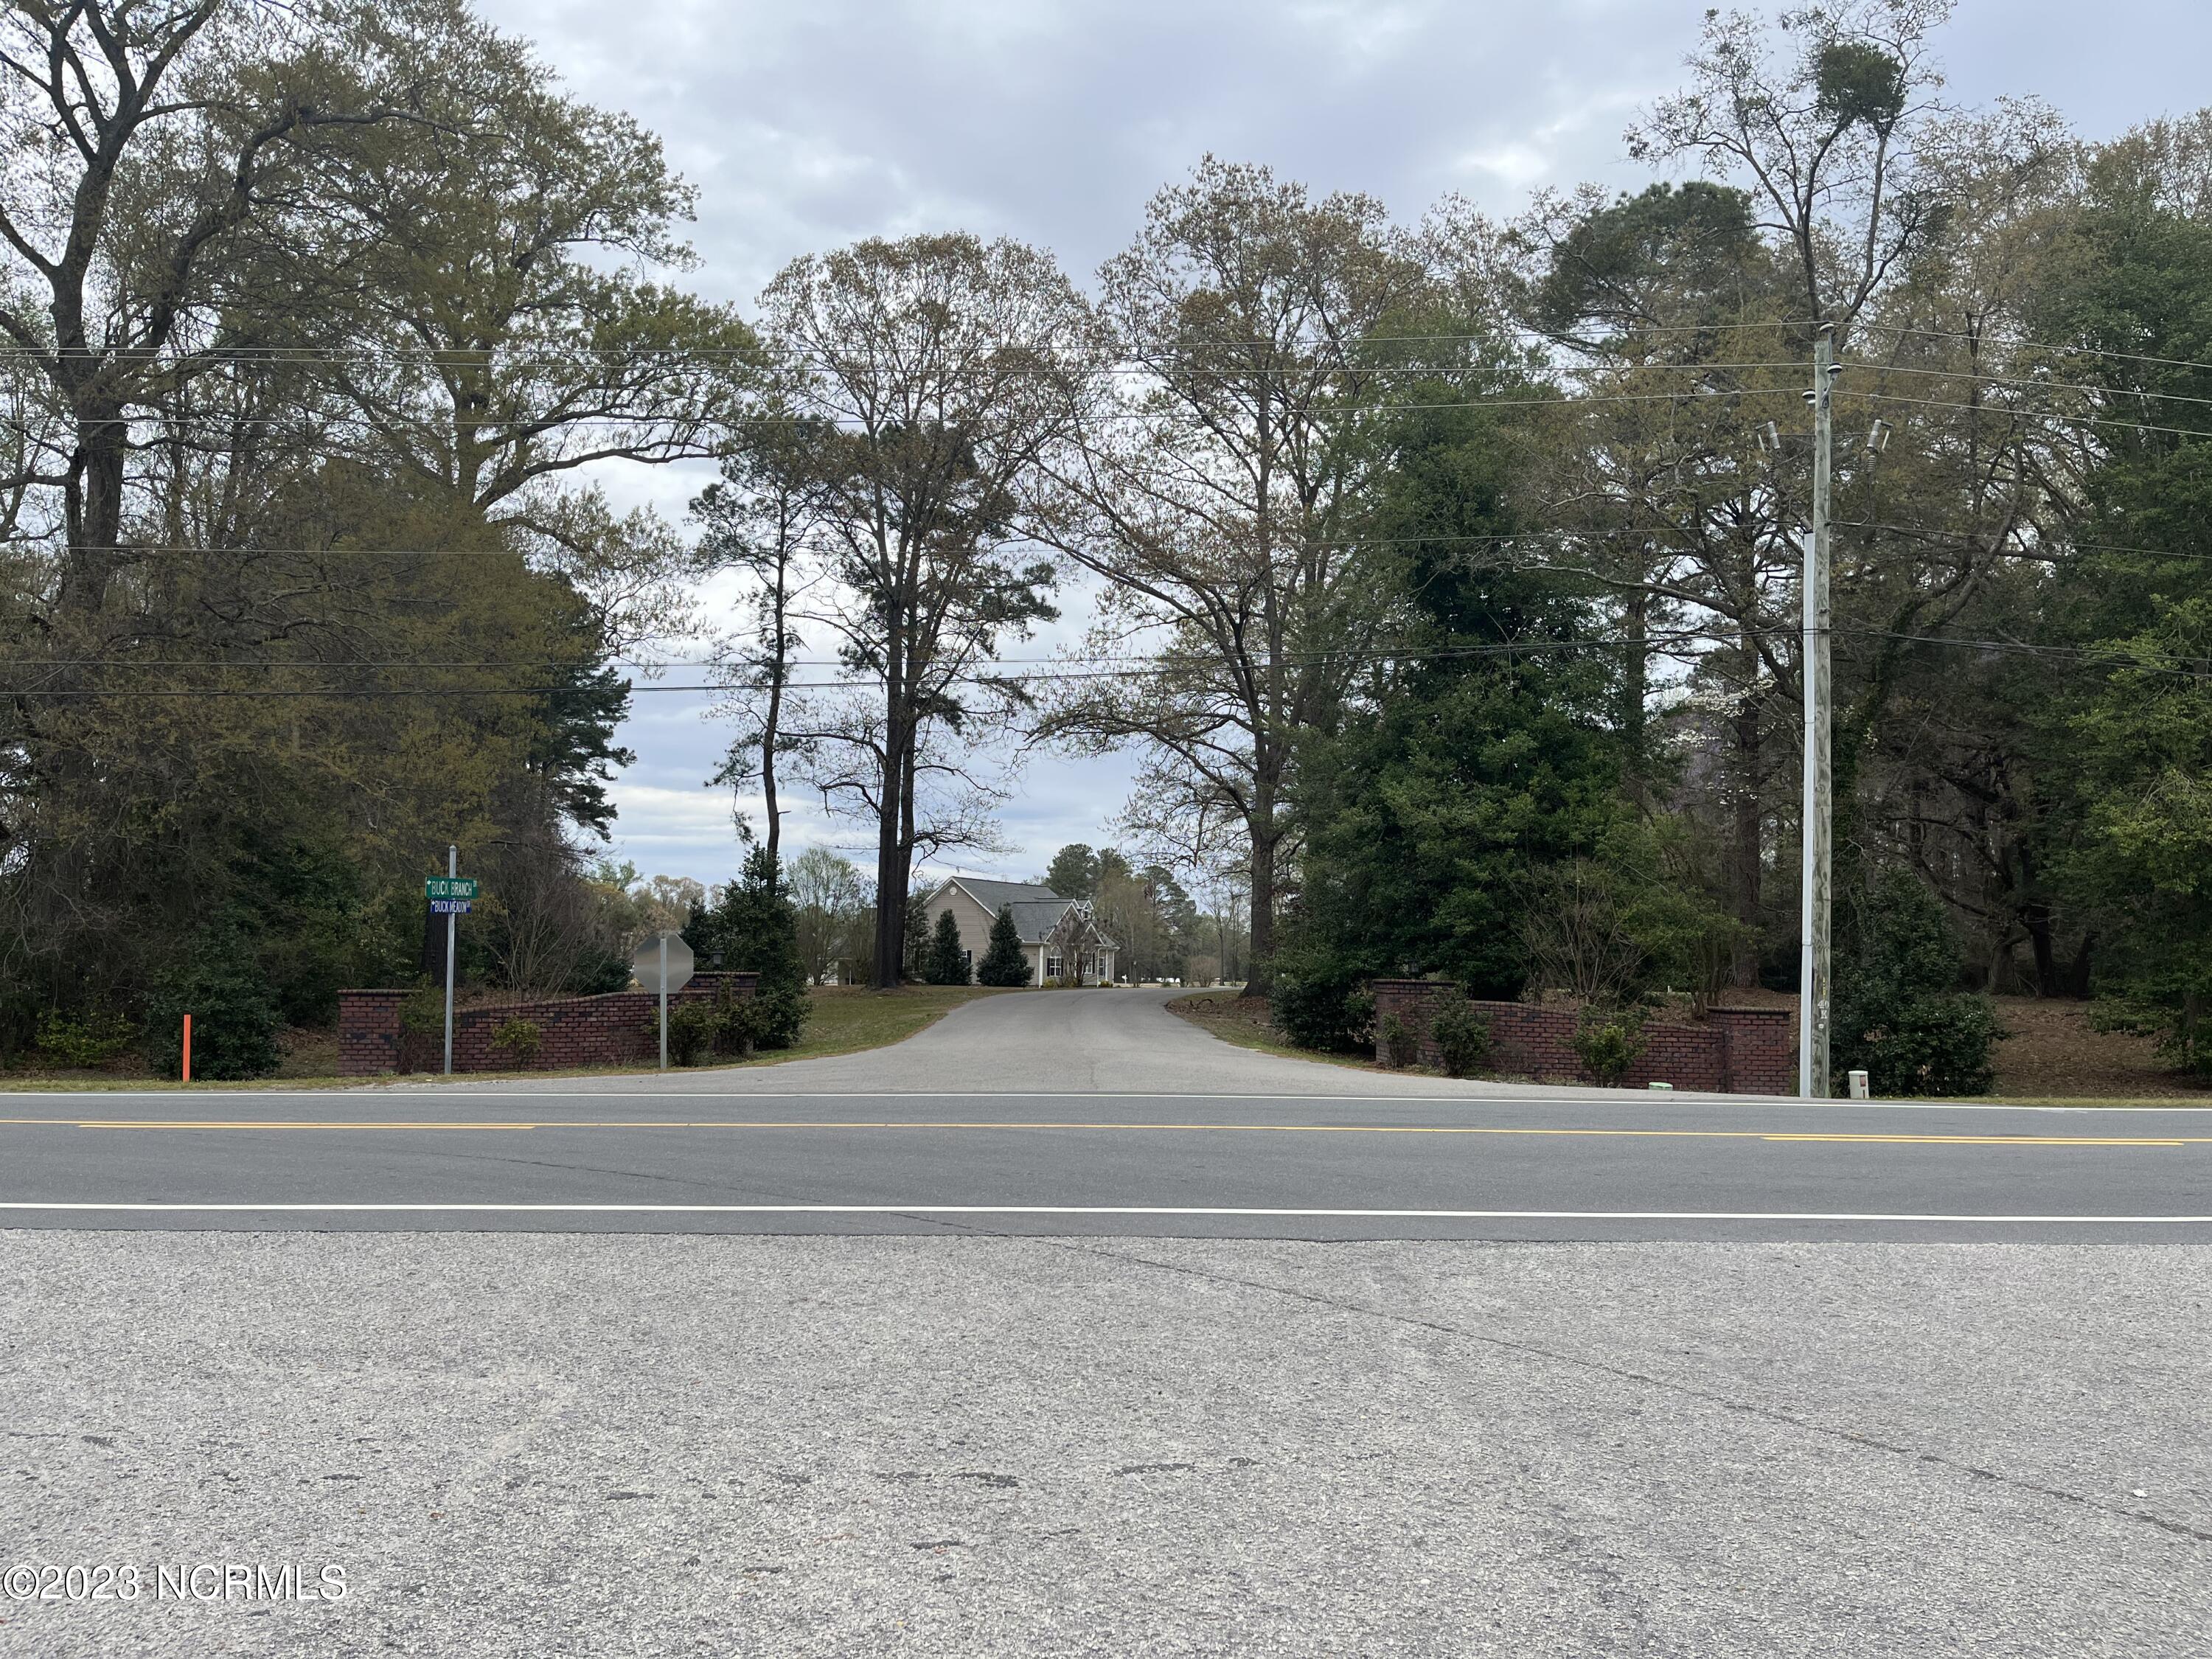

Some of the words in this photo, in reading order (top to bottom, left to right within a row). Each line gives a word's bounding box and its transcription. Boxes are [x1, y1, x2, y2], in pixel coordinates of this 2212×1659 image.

[431, 880, 449, 895] BUCK
[451, 881, 472, 896] BRANCH
[434, 900, 449, 913] BUCK
